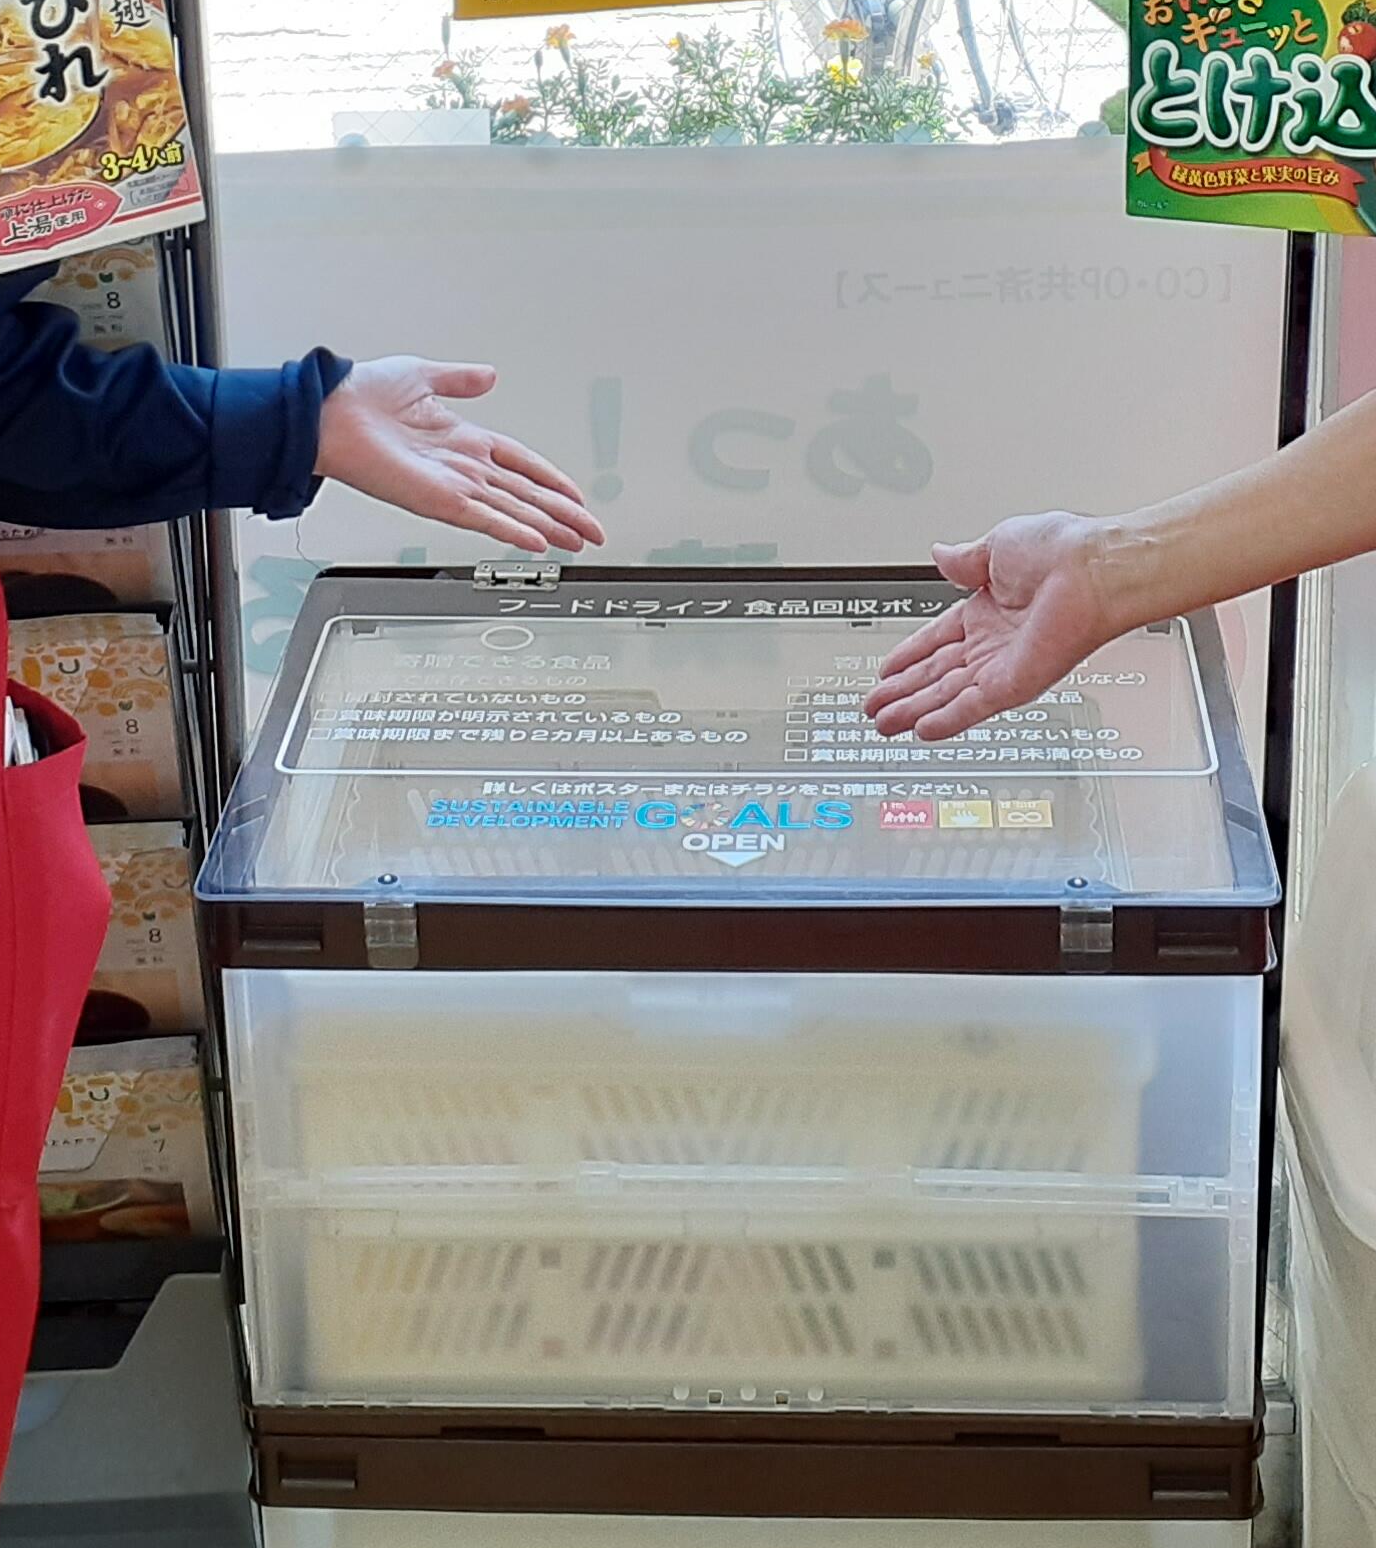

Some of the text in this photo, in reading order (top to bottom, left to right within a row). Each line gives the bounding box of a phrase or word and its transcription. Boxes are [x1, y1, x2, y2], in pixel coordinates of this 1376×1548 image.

[1181, 7, 1319, 52] ギューッと
[1171, 164, 1340, 188] 緑黄色野菜と果実の旨み
[106, 292, 121, 309] 8
[498, 598, 960, 616] フードドライブ 食品回収ボッ
[338, 709, 682, 725] 賞味期限が明示されているもの
[482, 782, 991, 798] 詳しくはポスターまたはチラシをご確認ください。
[431, 799, 630, 814] SUSTAINABLE
[427, 814, 624, 829] DEVELOPMENT
[682, 833, 785, 851] OPEN
[148, 928, 162, 943] 8
